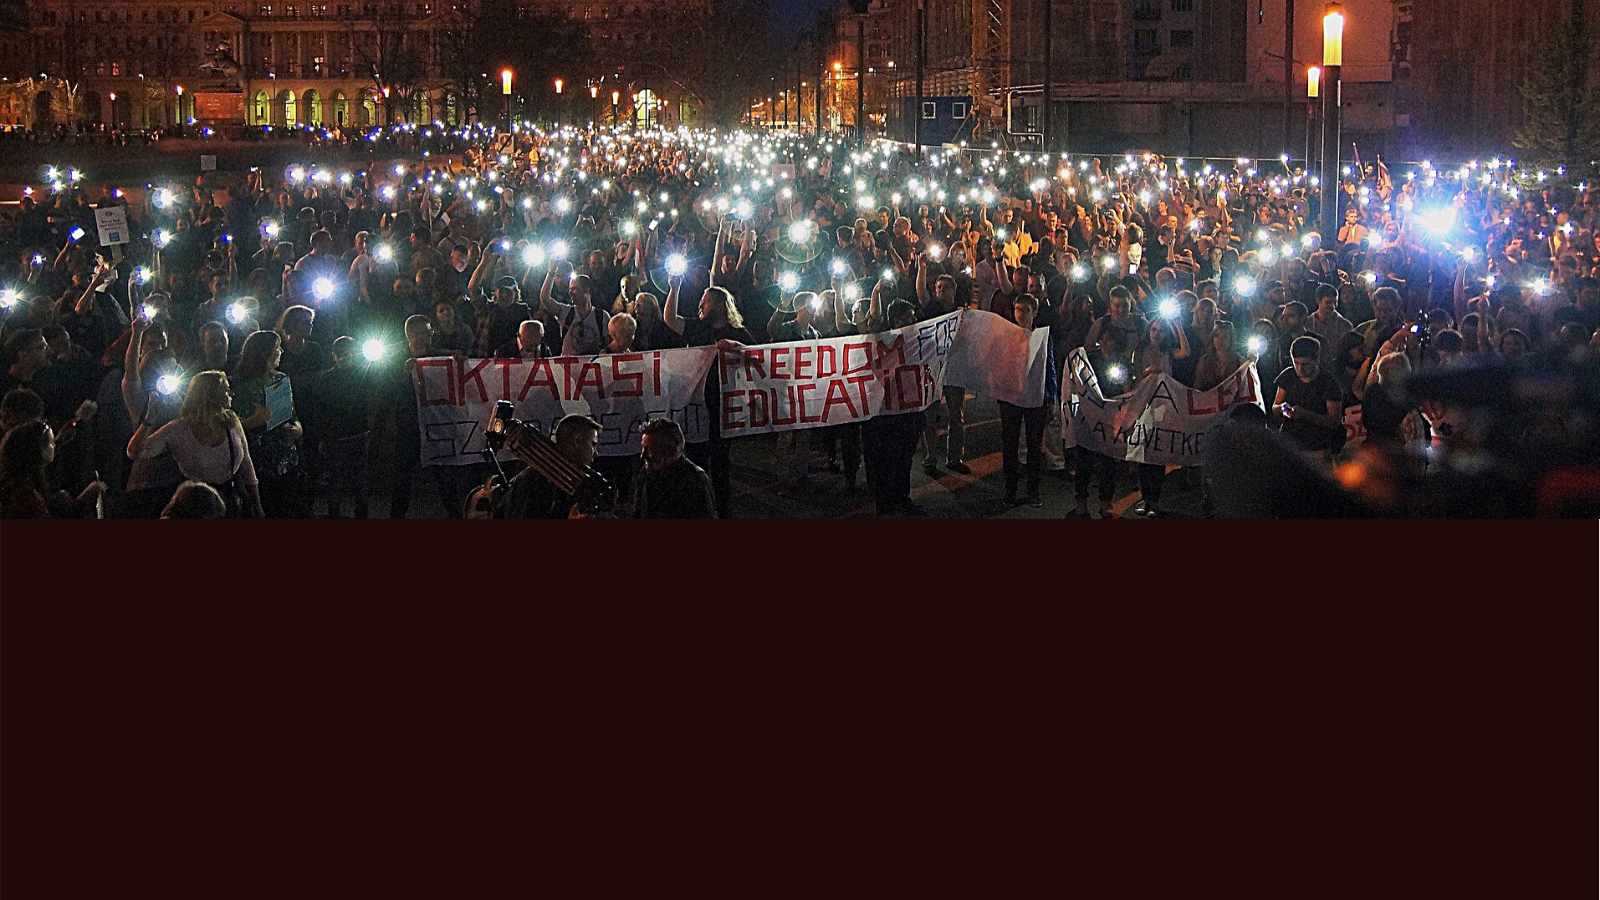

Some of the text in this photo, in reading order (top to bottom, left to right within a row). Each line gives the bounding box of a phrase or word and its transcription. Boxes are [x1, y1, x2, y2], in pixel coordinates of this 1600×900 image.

[720, 317, 958, 384] FREEDOM FOR
[1147, 380, 1179, 413] A
